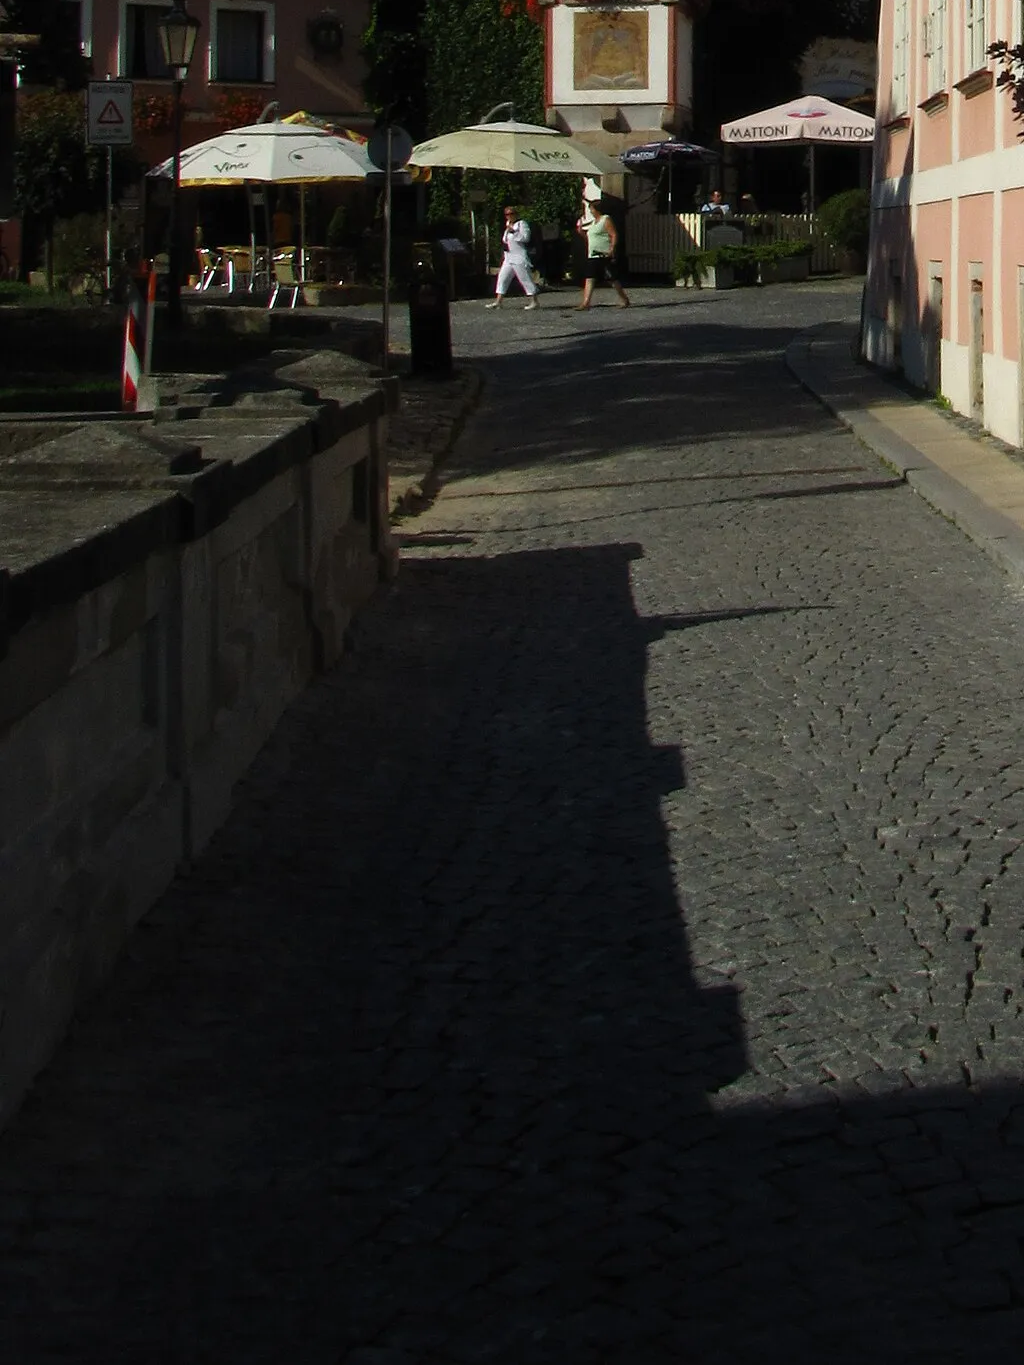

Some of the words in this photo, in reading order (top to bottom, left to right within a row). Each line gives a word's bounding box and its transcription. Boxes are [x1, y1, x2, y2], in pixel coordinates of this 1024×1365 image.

[728, 125, 788, 139] MATTONI
[818, 125, 874, 138] MATTON
[520, 148, 570, 162] Vinea
